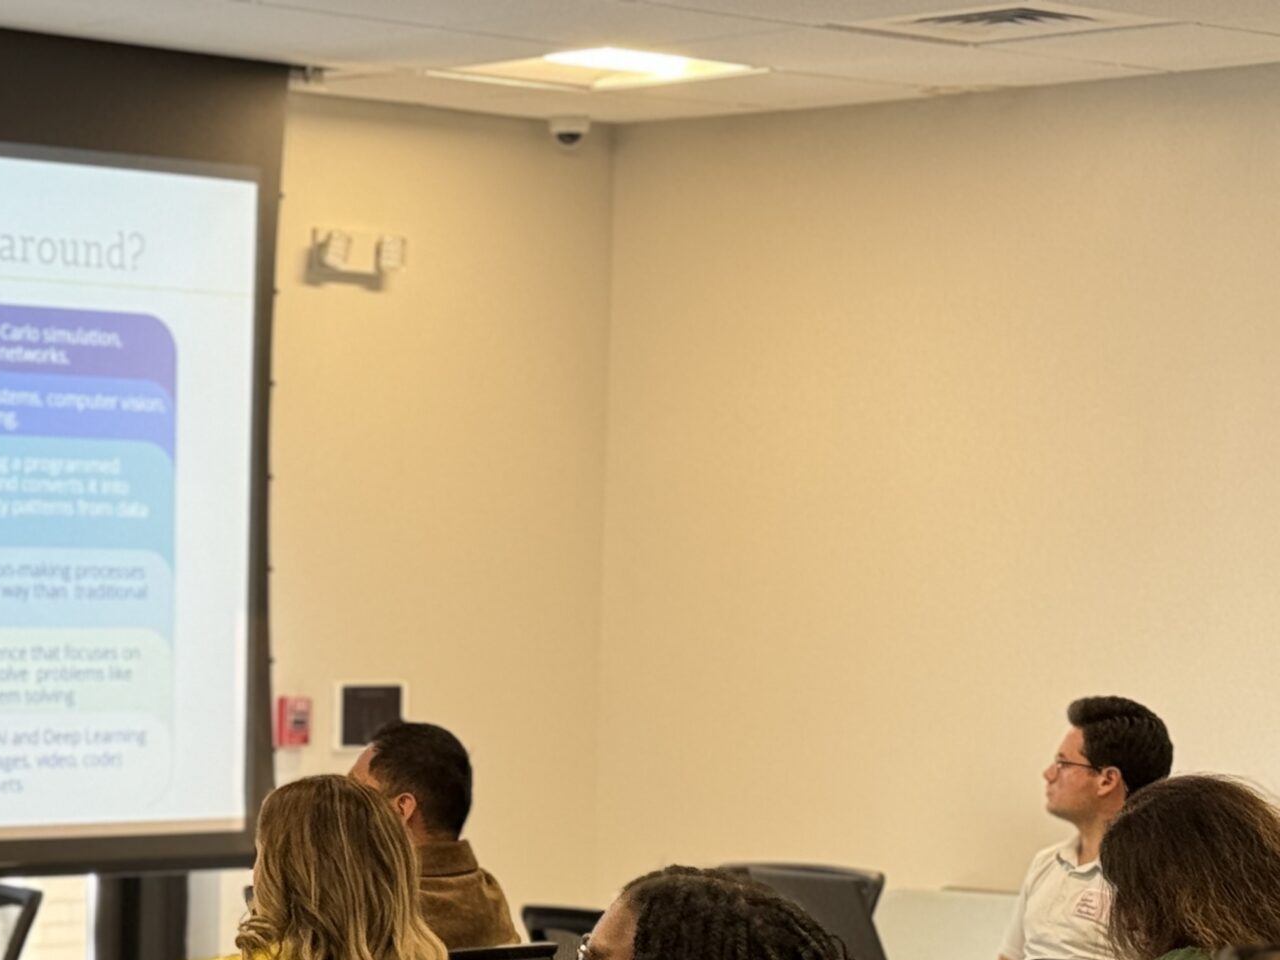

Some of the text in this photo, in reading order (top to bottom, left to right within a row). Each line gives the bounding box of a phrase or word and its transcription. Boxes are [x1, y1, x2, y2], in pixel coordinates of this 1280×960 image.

[47, 391, 117, 412] computer
[74, 565, 146, 582] processes
[1, 586, 30, 602] way
[33, 584, 66, 599] than
[74, 584, 148, 600] traditional
[31, 646, 60, 661] that
[62, 646, 118, 661] focuses
[121, 649, 141, 661] on
[36, 667, 105, 686] problems
[108, 666, 133, 682] like
[12, 729, 39, 747] and
[43, 728, 81, 749] Deep
[85, 728, 148, 748] Learning
